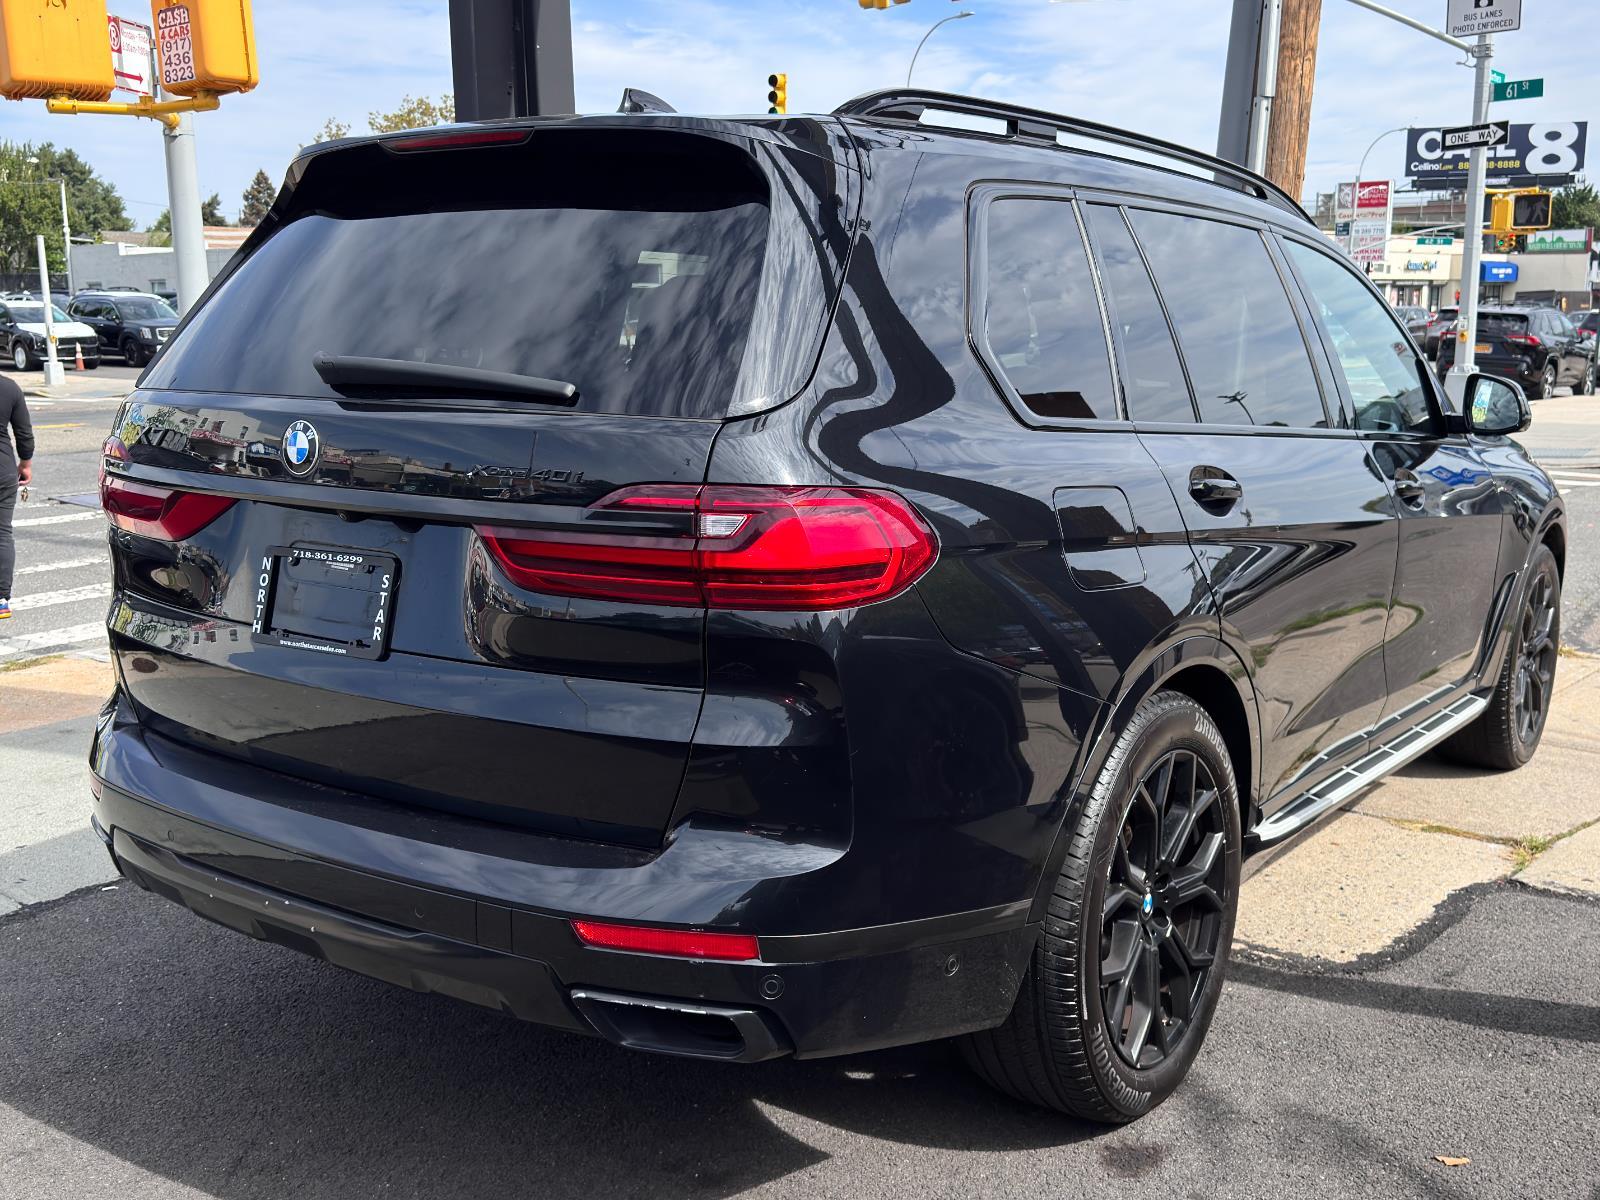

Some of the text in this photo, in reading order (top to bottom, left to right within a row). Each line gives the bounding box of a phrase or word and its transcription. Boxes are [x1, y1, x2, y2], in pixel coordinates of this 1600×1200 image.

[1463, 9, 1503, 22] BUS LANES
[161, 24, 190, 41] 4 CARS
[1452, 19, 1514, 33] PHOTO ENFORCED
[162, 37, 191, 56] (917)
[165, 52, 191, 67] 436
[164, 66, 194, 84] 8323
[1506, 84, 1517, 98] 61
[1450, 129, 1499, 144] ONE WAY
[1525, 122, 1579, 174] 8
[286, 422, 315, 440] BMW
[293, 549, 363, 564] 718-361-6299
[252, 556, 272, 634] NORTH
[372, 574, 390, 641] STAR
